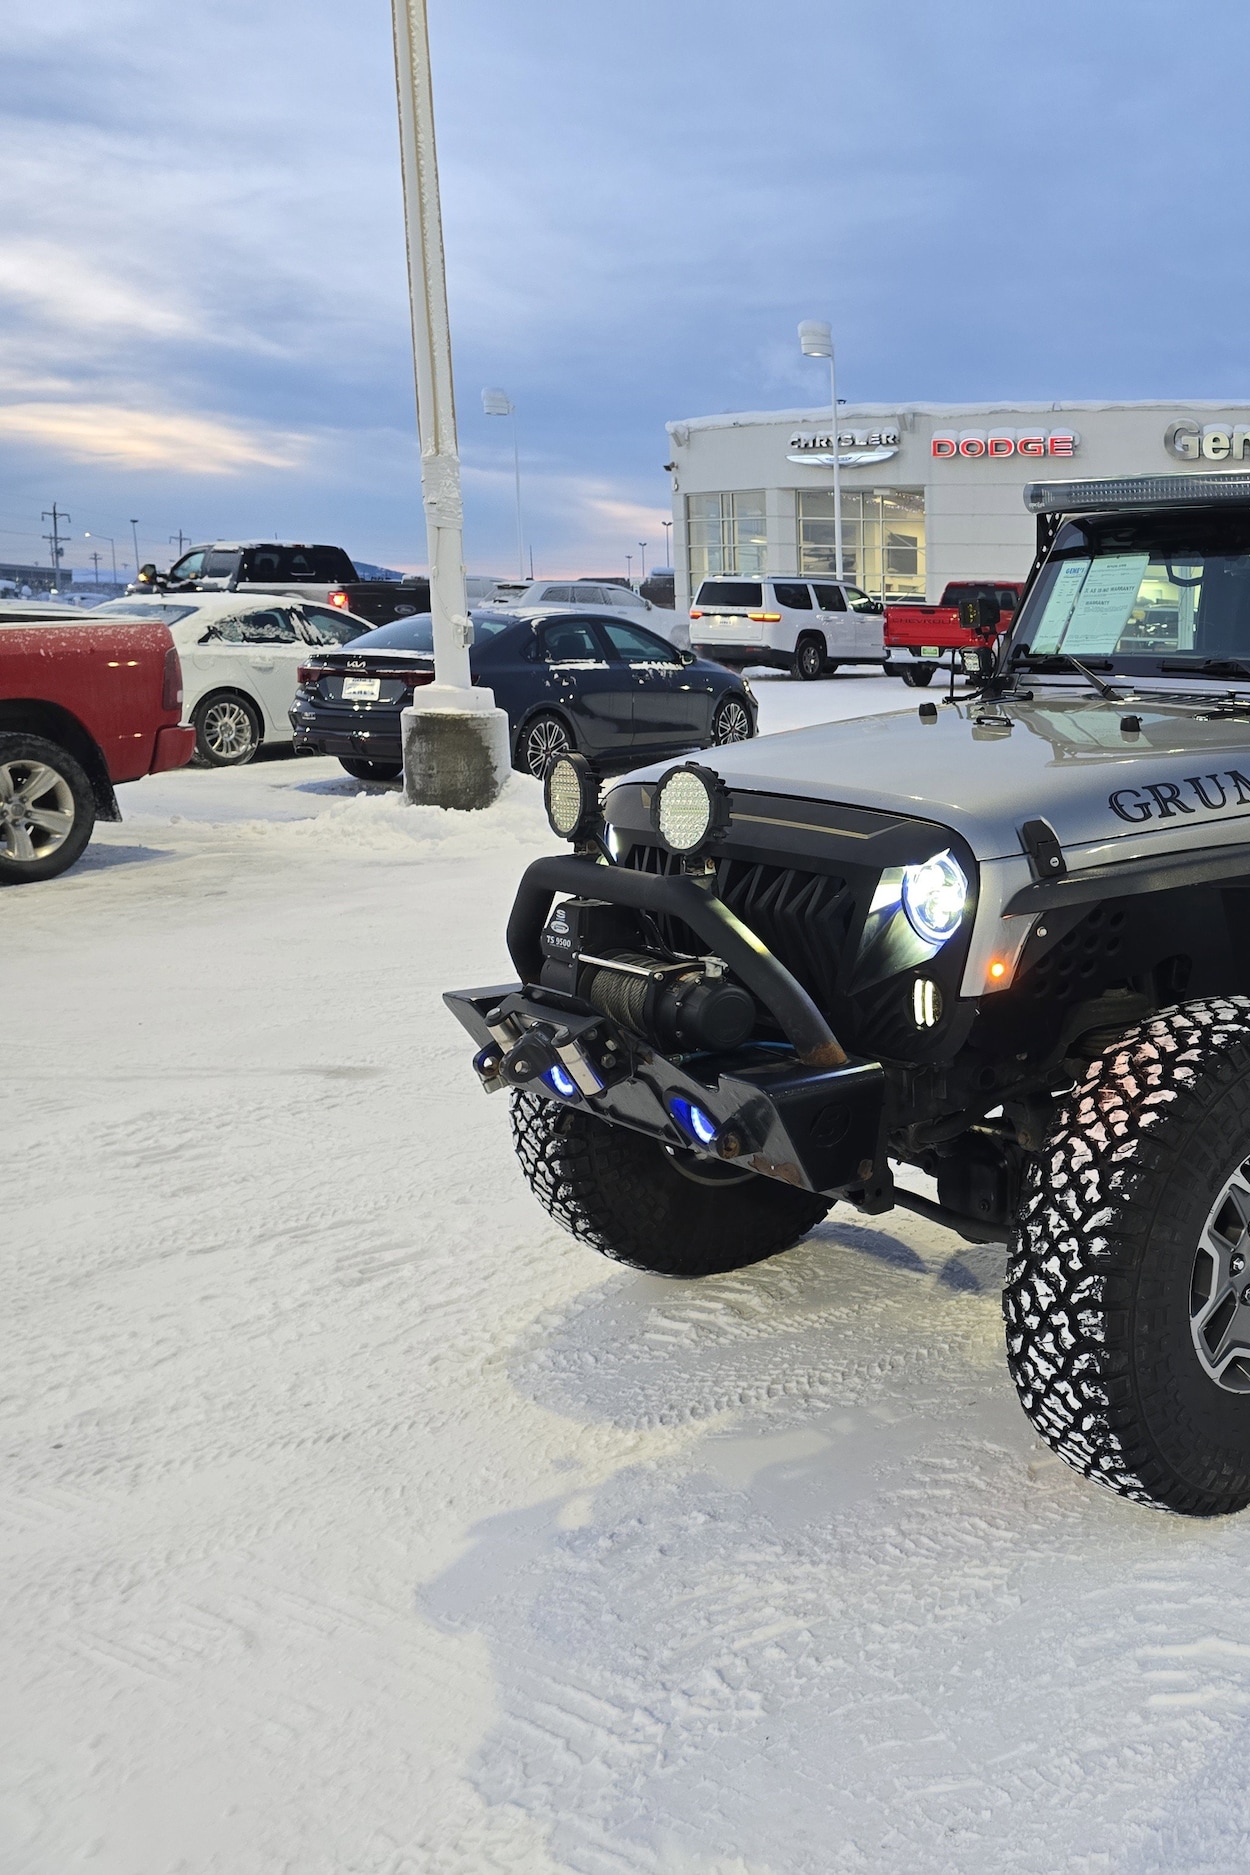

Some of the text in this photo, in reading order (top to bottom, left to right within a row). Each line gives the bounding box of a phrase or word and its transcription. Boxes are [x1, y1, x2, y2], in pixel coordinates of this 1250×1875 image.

[931, 435, 1073, 458] DODGE
[891, 617, 958, 625] CHEVROLE
[546, 935, 555, 945] TS
[555, 937, 571, 948] 9500
